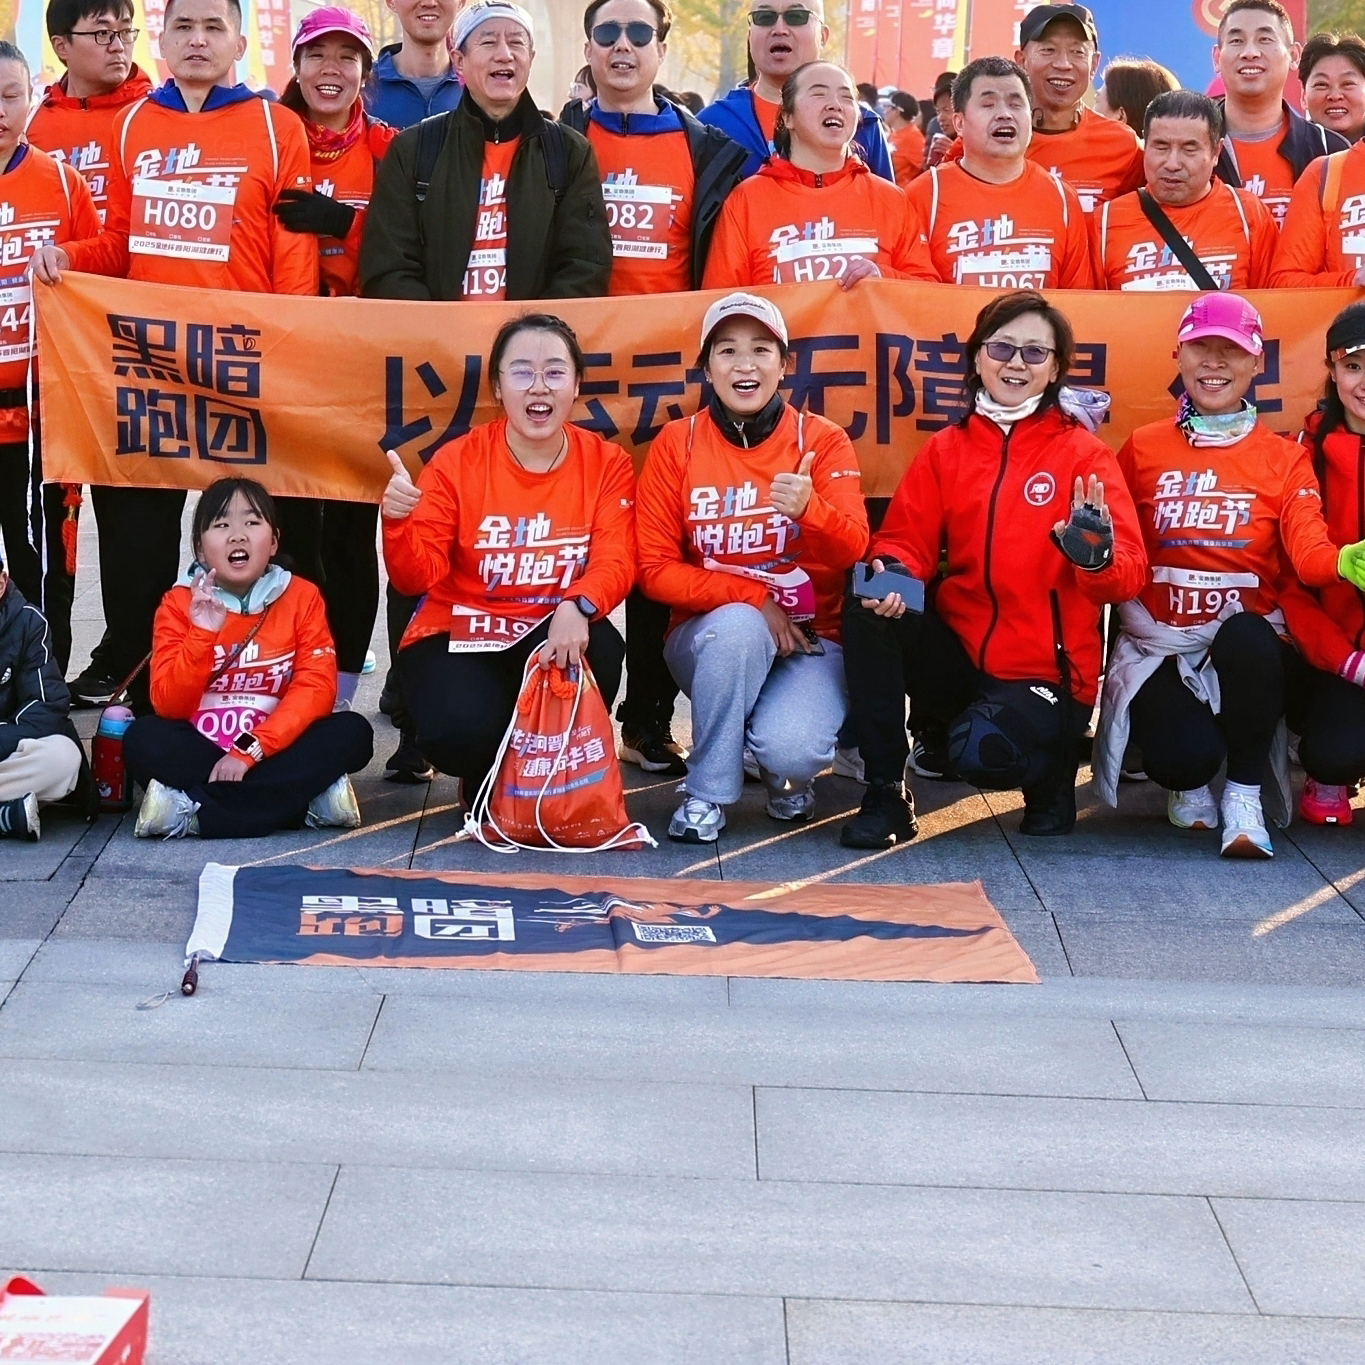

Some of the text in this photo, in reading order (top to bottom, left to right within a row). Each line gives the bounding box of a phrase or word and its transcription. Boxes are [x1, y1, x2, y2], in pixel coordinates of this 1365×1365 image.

[133, 143, 249, 179] 金地
[143, 199, 217, 231] H080
[946, 213, 1055, 254] 金地
[768, 216, 879, 258] 金地
[106, 313, 263, 400] 黑暗
[114, 388, 267, 466] 跑团
[688, 481, 778, 521] 金地
[1153, 468, 1257, 501] 金地
[474, 512, 591, 550] 金地
[693, 513, 801, 558] 悦跑节
[1153, 499, 1251, 534] 悦跑节
[478, 545, 589, 592] 悦跑节
